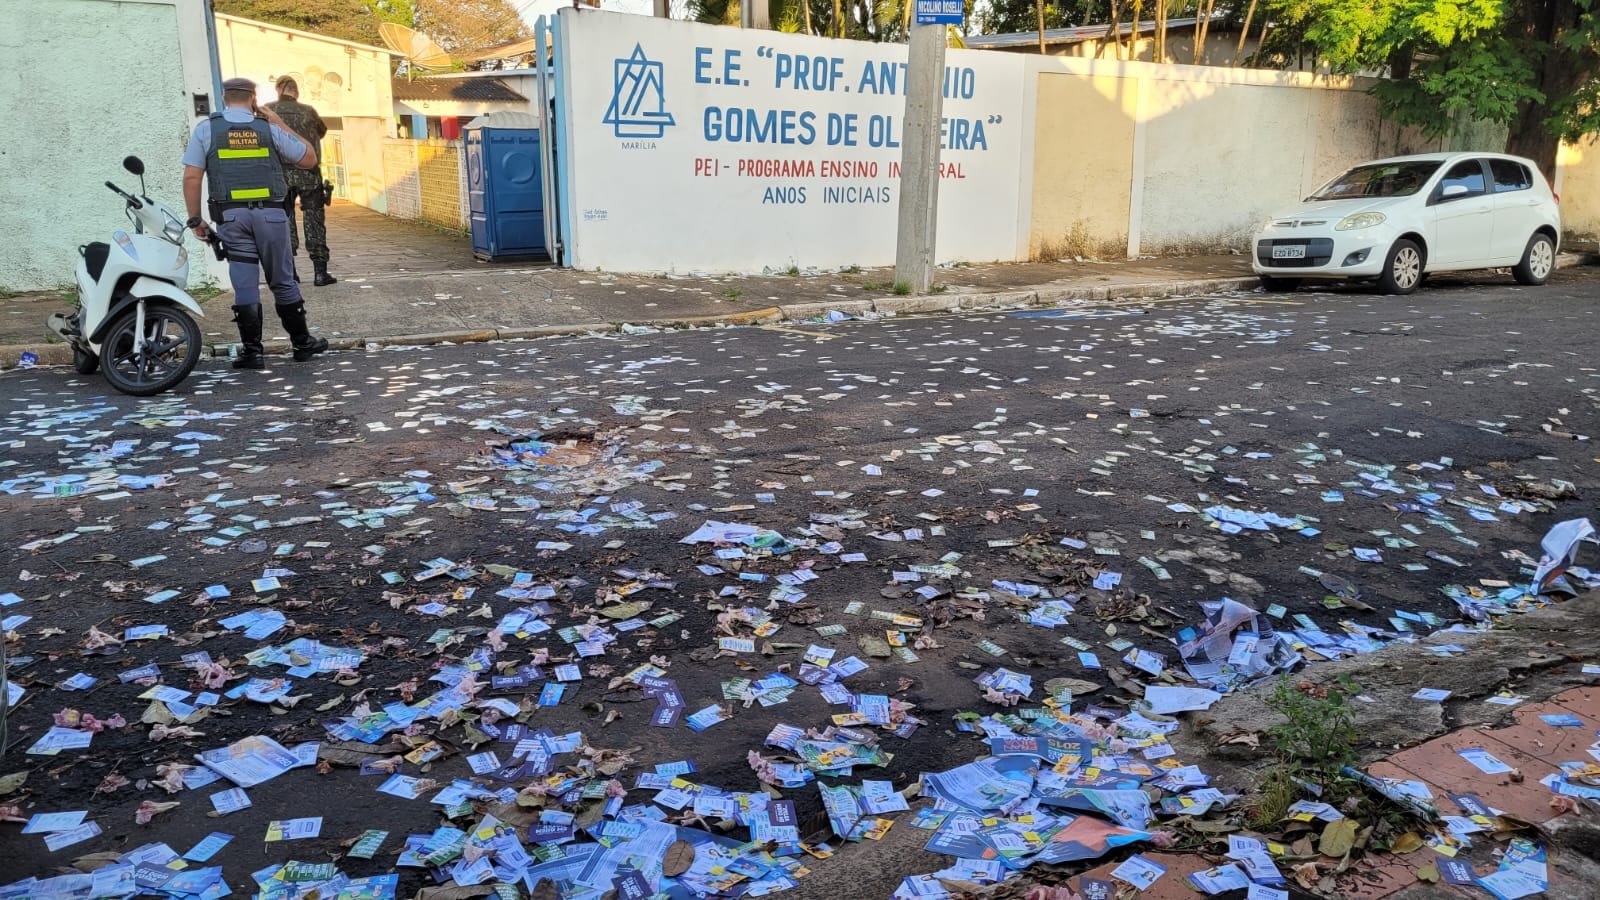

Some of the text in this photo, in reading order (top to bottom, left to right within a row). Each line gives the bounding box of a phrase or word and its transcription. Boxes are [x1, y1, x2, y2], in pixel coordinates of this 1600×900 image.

[918, 1, 963, 13] NICOLINO ROSELLI
[695, 46, 750, 87] E.E.
[704, 105, 817, 145] GOMES
[827, 113, 858, 147] DE
[694, 158, 719, 177] PEI
[738, 158, 815, 178] PROGRAMA
[820, 160, 878, 178] ENSINO
[762, 186, 890, 204] ANOS INICIAIS
